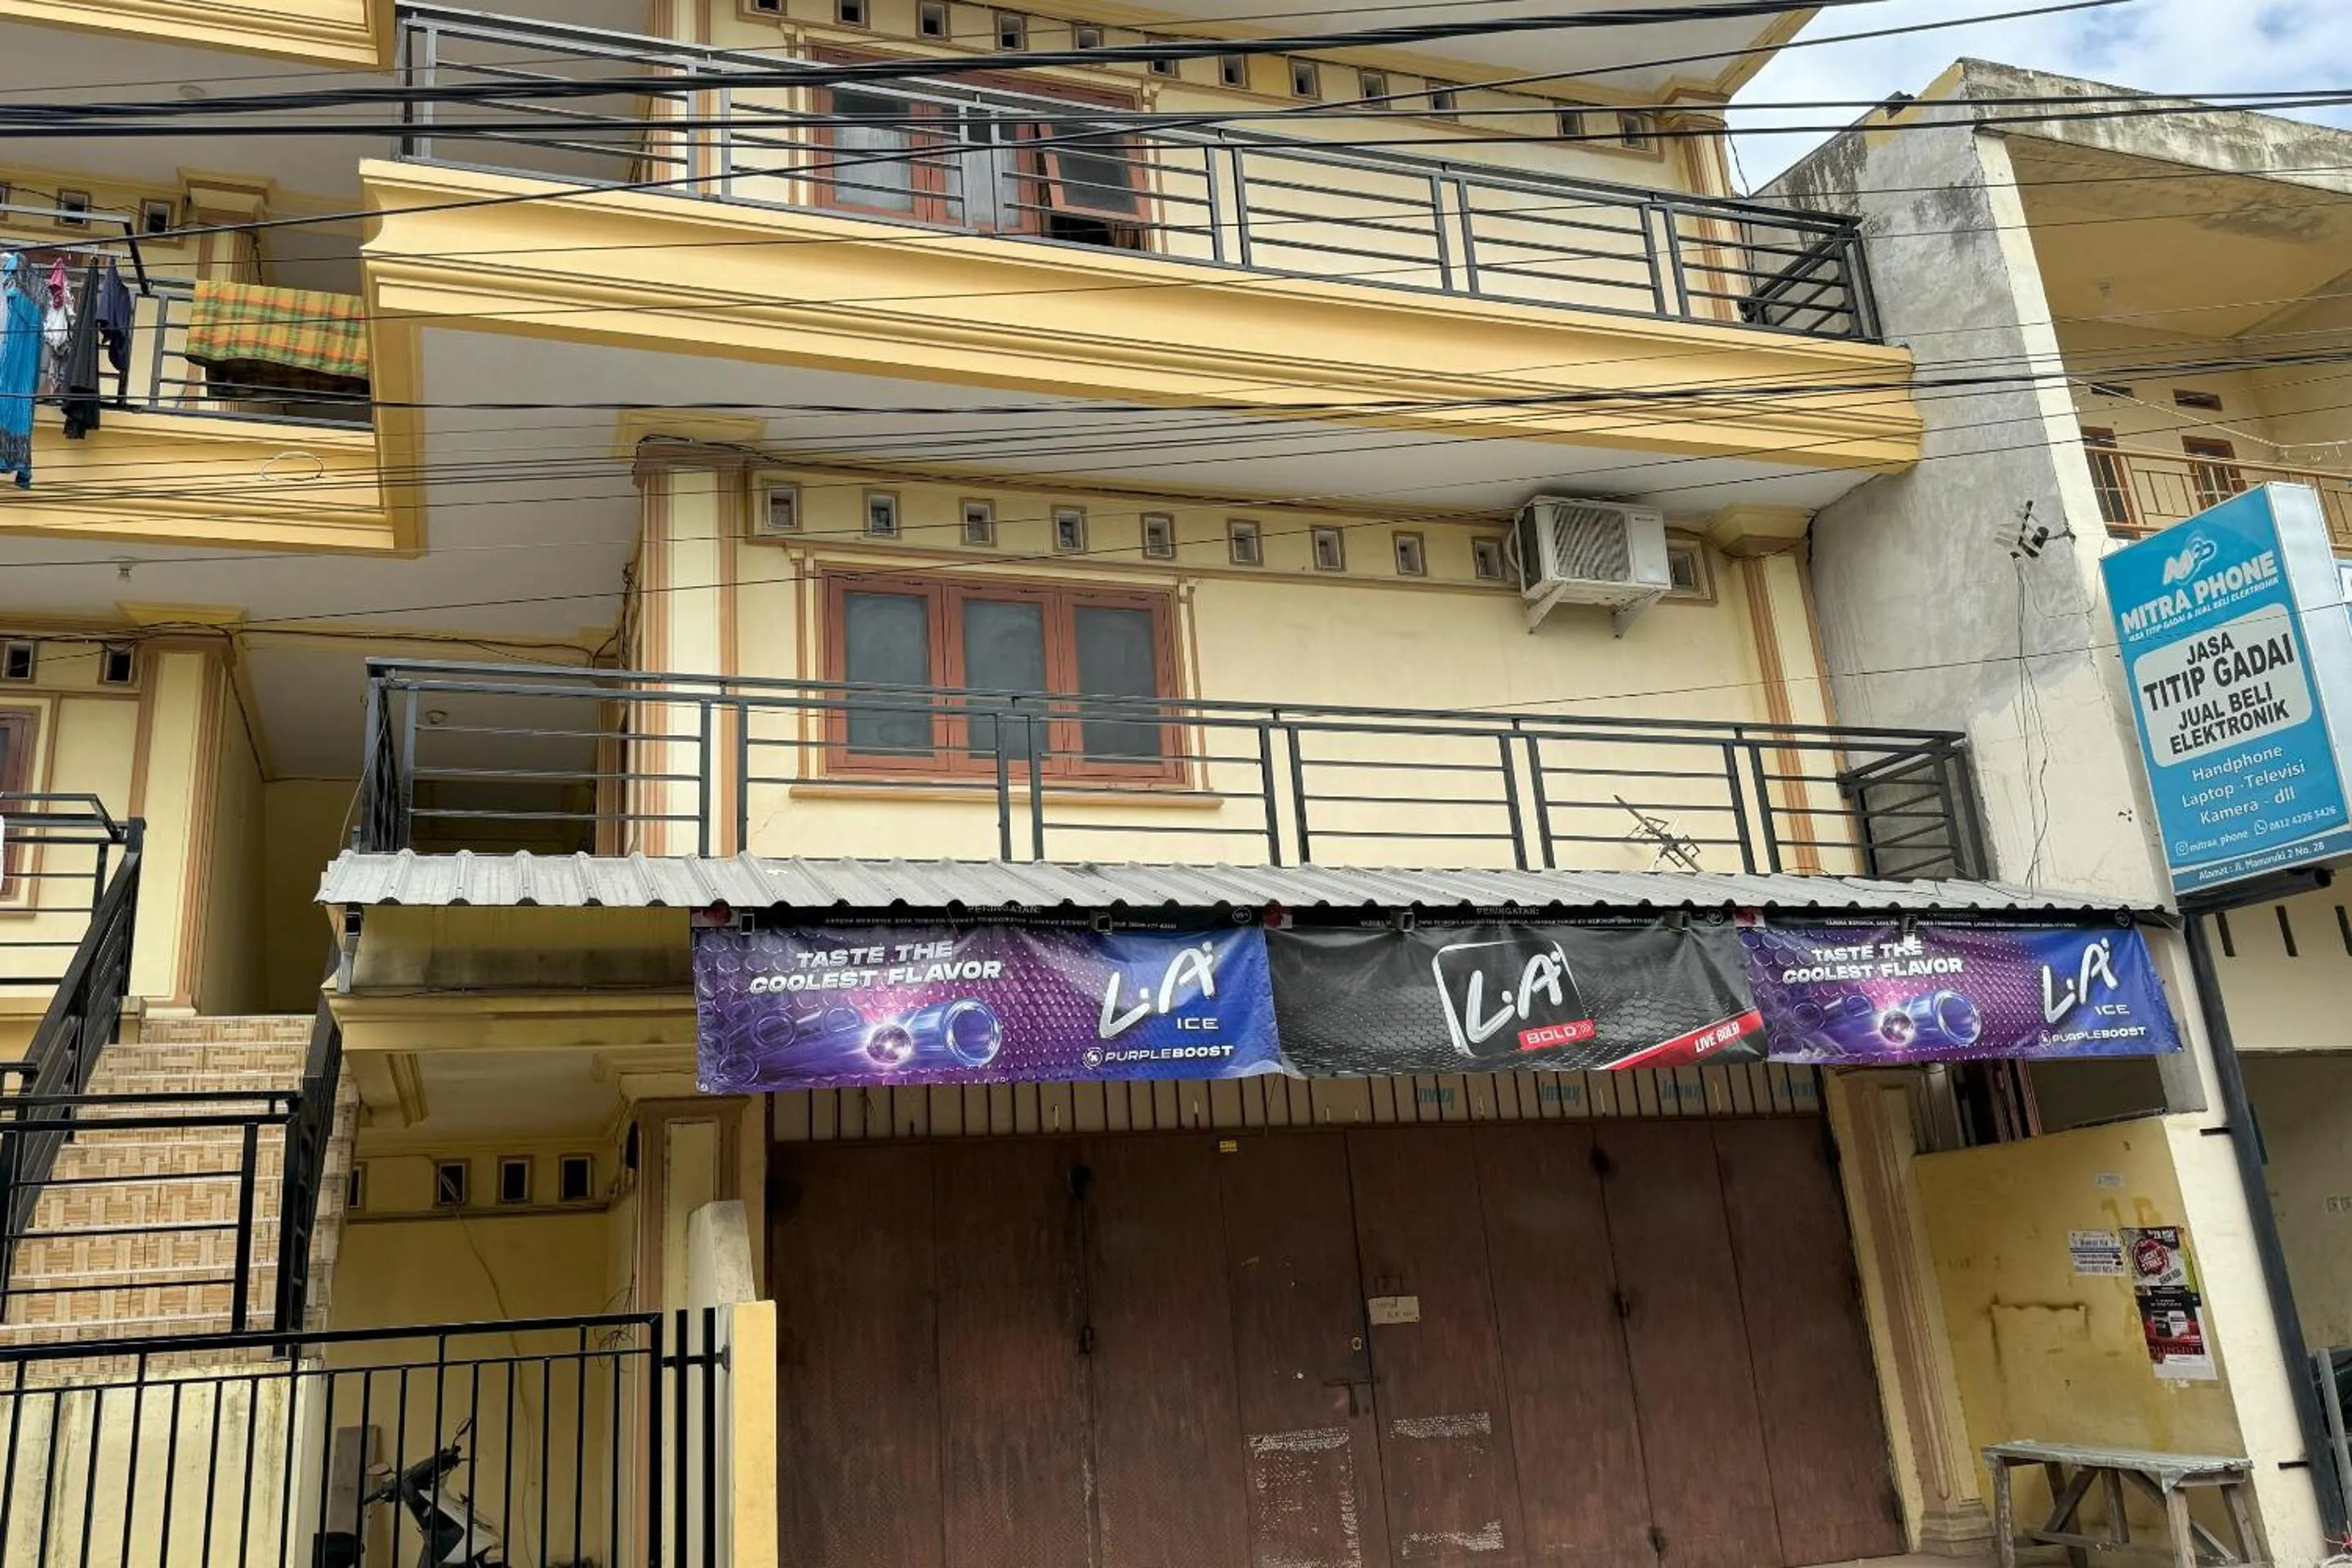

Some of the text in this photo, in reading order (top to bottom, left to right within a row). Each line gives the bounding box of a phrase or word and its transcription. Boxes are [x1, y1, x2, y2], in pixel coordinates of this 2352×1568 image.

[2122, 550, 2278, 635] MITRA PHONE
[2186, 631, 2235, 665] JASA
[2143, 633, 2295, 711] TITIP GADAI
[2178, 681, 2273, 730] JUAL BELI
[2169, 699, 2290, 755] ELEKTRONIK
[2192, 745, 2283, 782] Handphone
[2182, 784, 2234, 808] Laptop
[2200, 800, 2259, 825] Kamera
[2274, 786, 2296, 804] dll
[796, 940, 953, 969] TASTE THE
[1811, 940, 1923, 962] TASTE THE
[748, 960, 1001, 994] COOLEST FLAVOR
[1782, 957, 1964, 984] COOLEST FLAVOR
[1177, 1017, 1219, 1030] ICE
[2095, 1004, 2130, 1016] ICE
[1526, 1026, 1577, 1045] BOLD
[1694, 1022, 1740, 1054] LIVE BOLD
[2052, 1027, 2145, 1042] PURPLEBOOST
[1105, 1045, 1235, 1062] PURPLEBOOST
